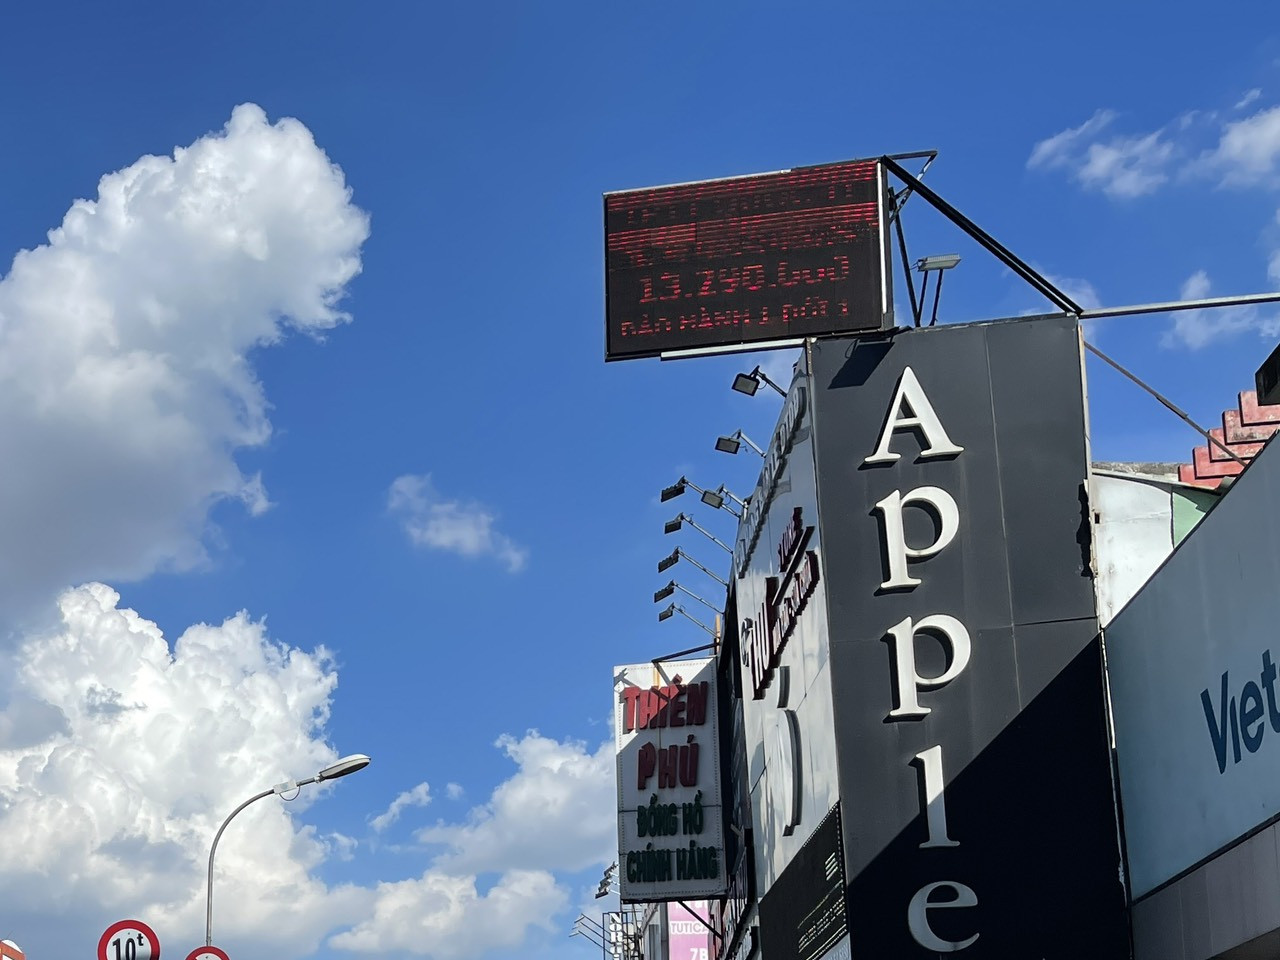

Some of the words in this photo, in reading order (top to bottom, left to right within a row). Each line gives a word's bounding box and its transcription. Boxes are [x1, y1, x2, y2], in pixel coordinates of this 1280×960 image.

[865, 366, 980, 953] Apple
[638, 734, 699, 790] PHÚ
[637, 793, 678, 837] ĐỒNG
[683, 790, 703, 836] HỒ
[627, 842, 672, 883] CHÍNH
